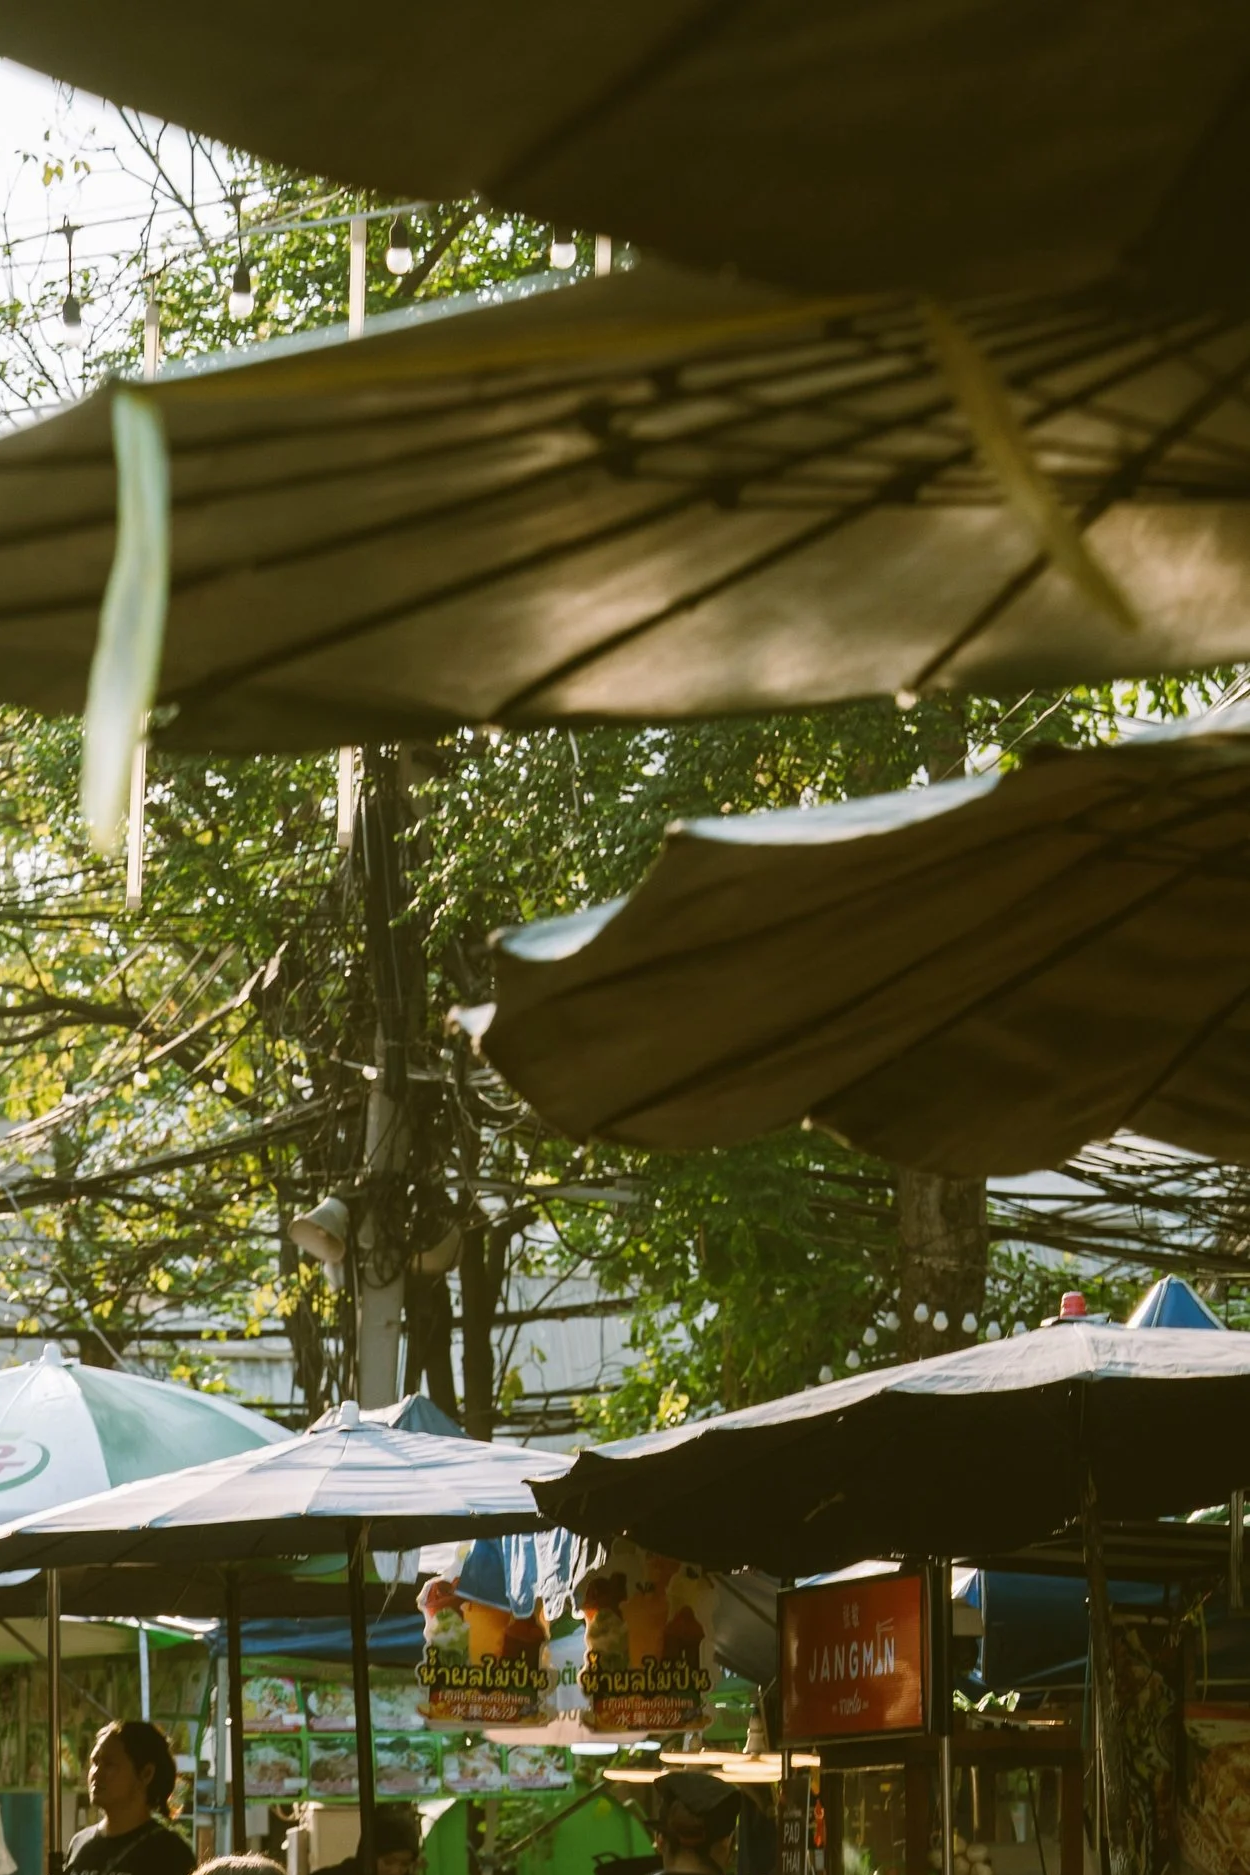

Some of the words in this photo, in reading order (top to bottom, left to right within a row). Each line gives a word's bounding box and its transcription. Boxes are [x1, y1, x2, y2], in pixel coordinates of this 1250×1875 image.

[420, 1648, 548, 1690] น้ำผลไม้ปั่น
[582, 1649, 711, 1694] น้ำผลไม้ปั่น
[783, 1820, 801, 1844] PAD
[781, 1850, 801, 1873] THAI
